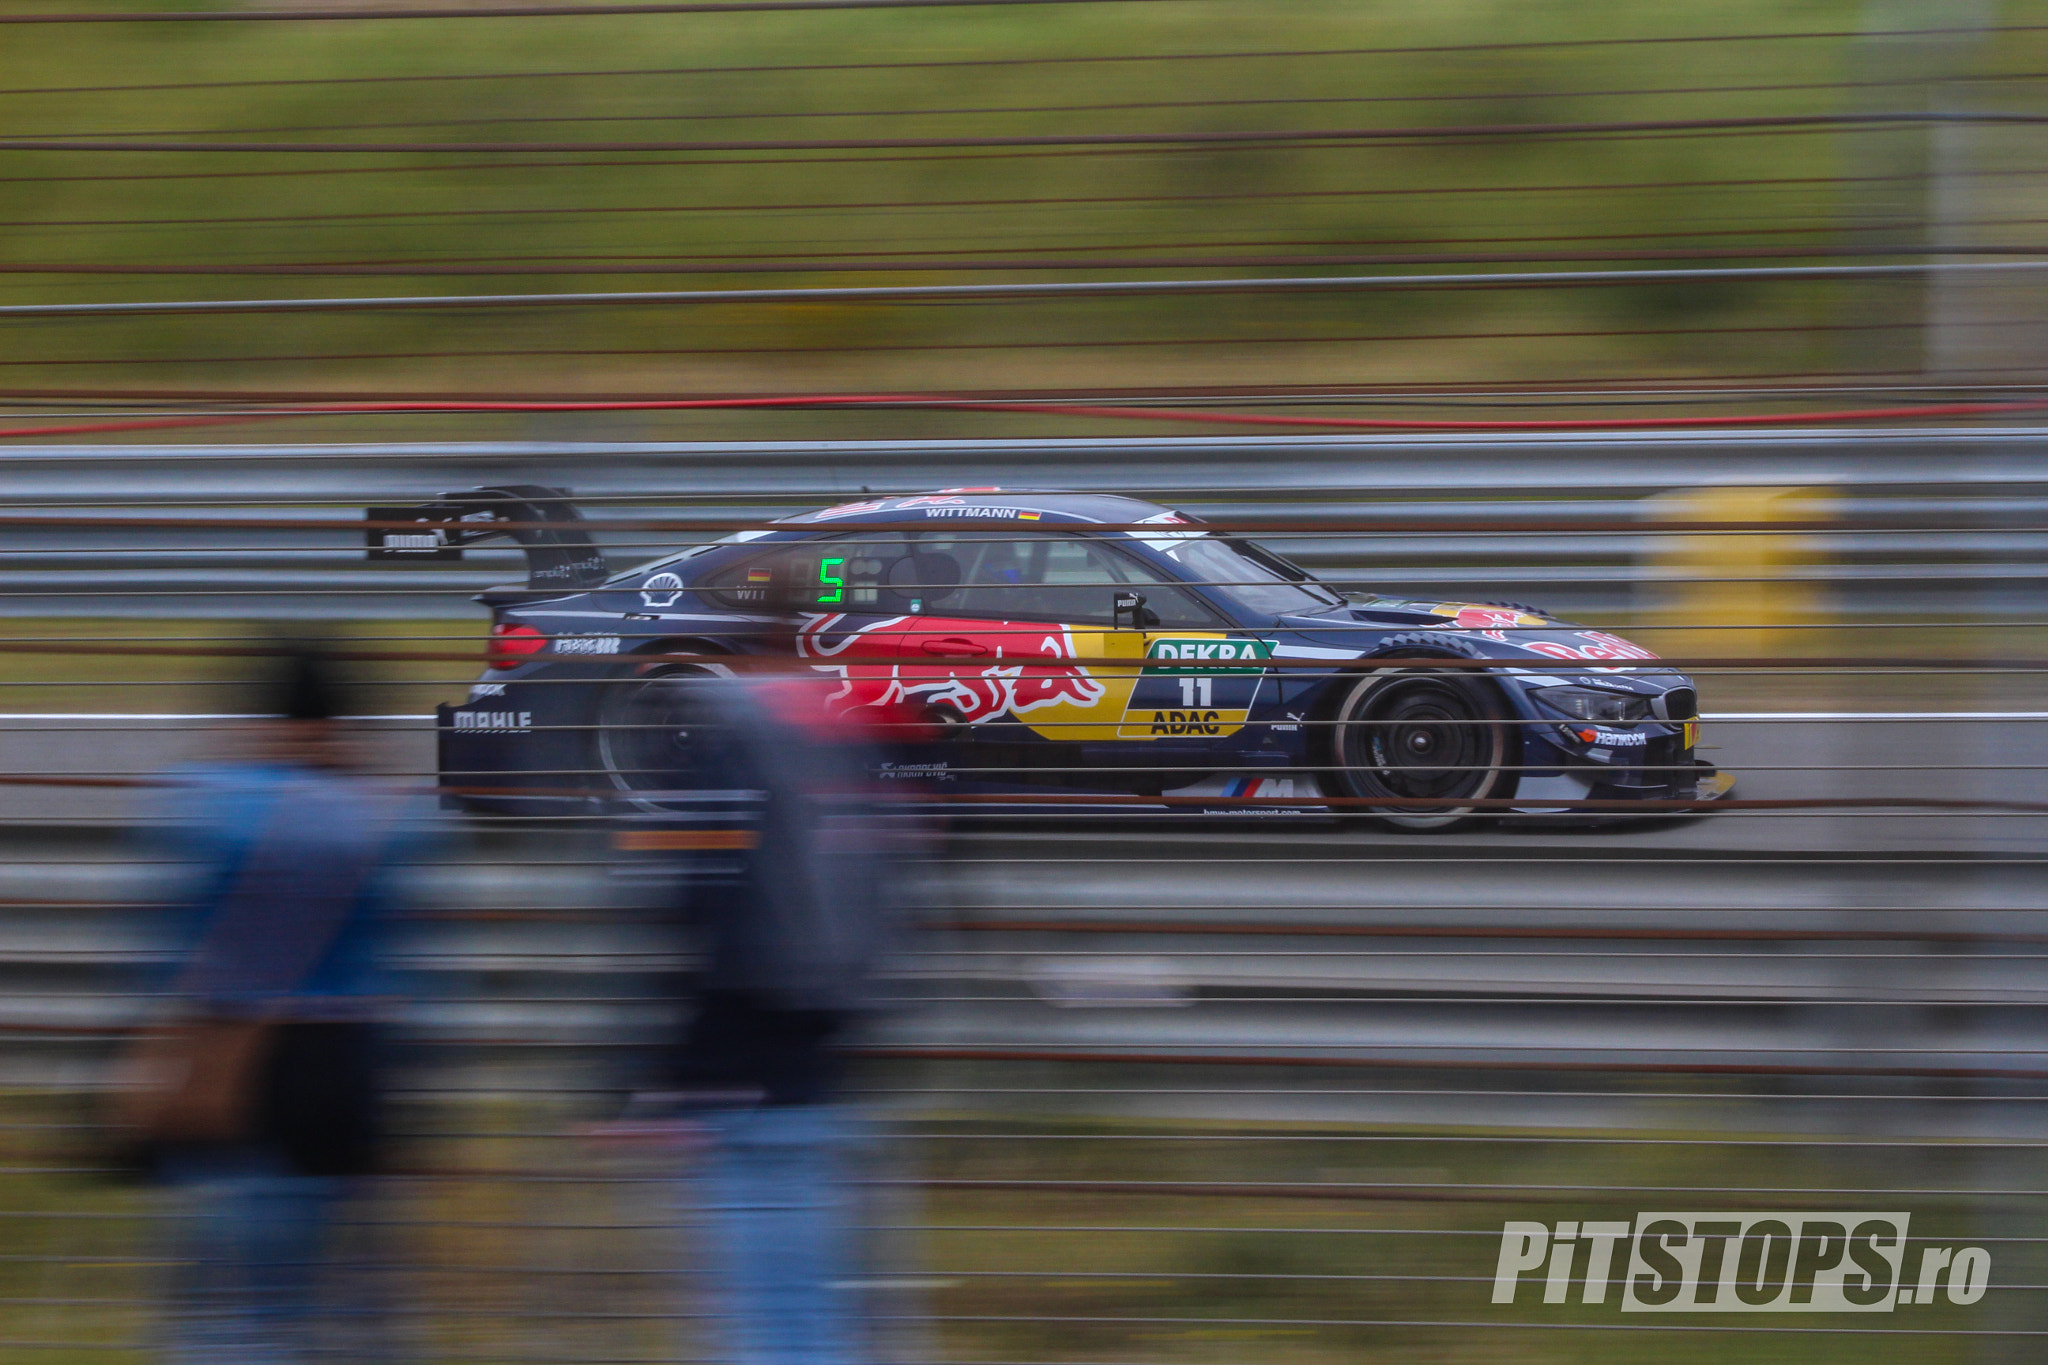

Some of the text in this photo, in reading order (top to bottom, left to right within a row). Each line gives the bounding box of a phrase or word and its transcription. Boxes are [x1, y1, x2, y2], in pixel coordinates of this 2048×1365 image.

[925, 507, 1016, 519] WITTMANN
[817, 558, 844, 602] 5
[1117, 598, 1136, 607] PUMA
[1157, 644, 1262, 669] DEKRA
[1178, 675, 1212, 706] 11
[453, 711, 532, 733] MAHLE
[1150, 711, 1220, 734] ADAC
